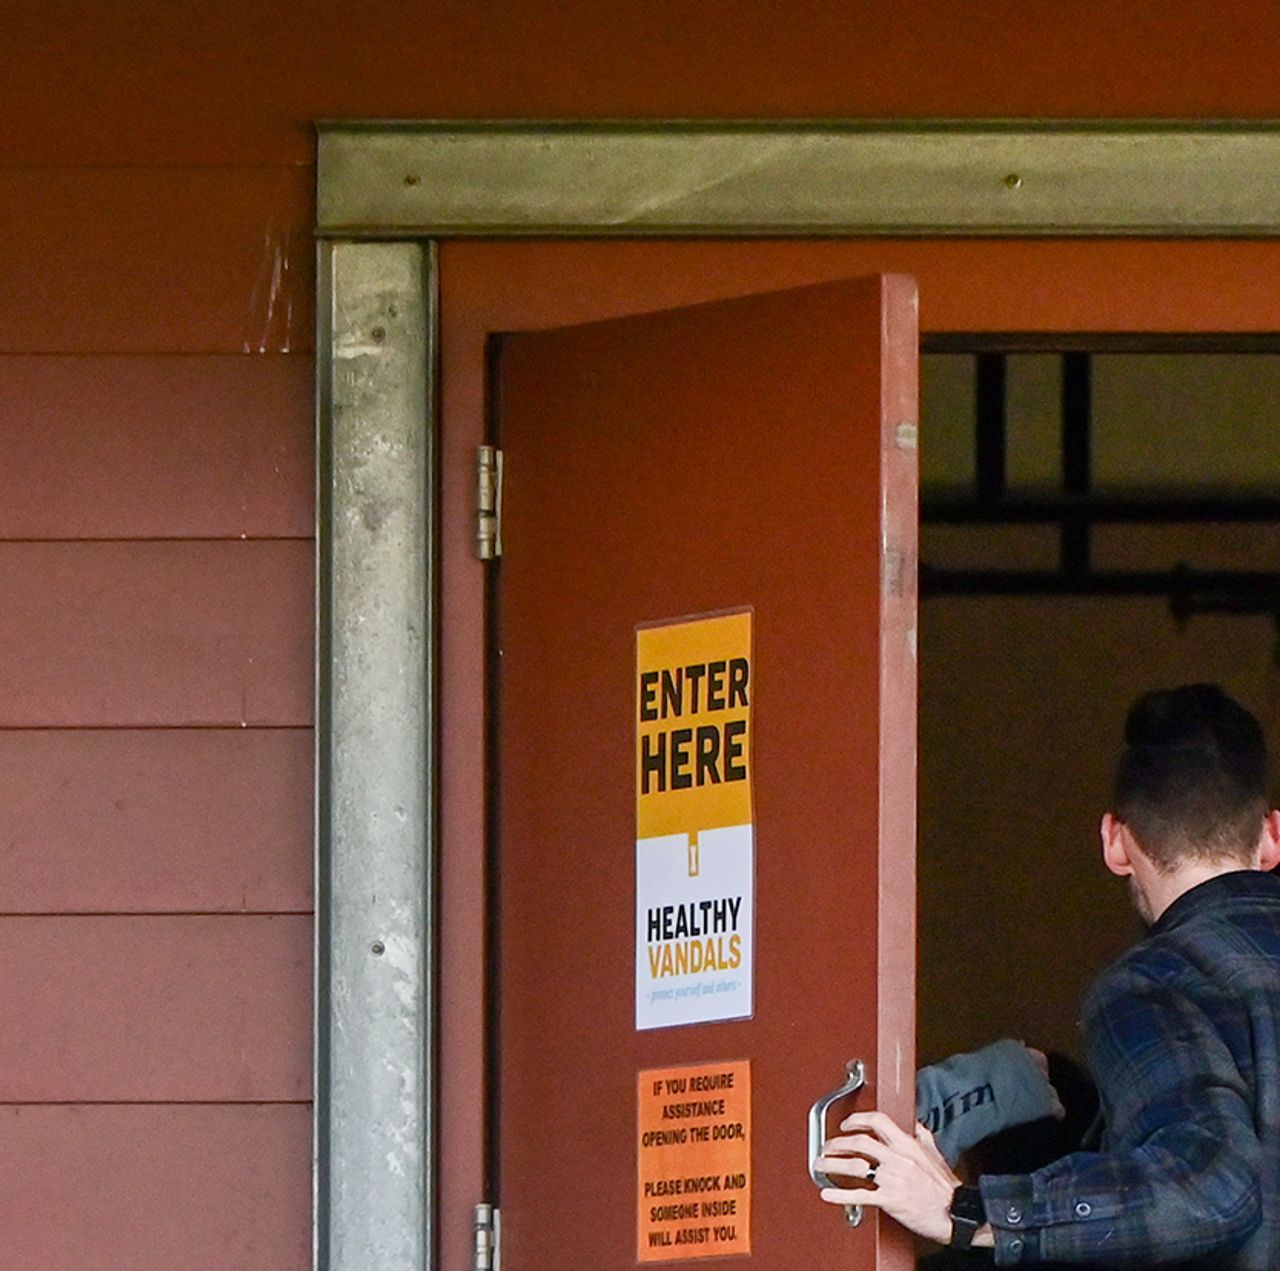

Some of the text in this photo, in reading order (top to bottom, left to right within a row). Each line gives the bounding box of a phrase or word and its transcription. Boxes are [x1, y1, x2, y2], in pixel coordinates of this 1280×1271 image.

[640, 657, 749, 722] ENTER
[641, 720, 746, 795] HERE
[647, 896, 742, 942] HEALTHY
[648, 934, 742, 979] VANDALS
[653, 1073, 734, 1096] IF YOU REQUIRE
[662, 1099, 725, 1120] ASSISTANCE
[642, 1122, 745, 1148] OPENING THE DOOR,
[644, 1173, 746, 1198] PLEASE KNOCK AND
[650, 1199, 736, 1222] SOMEONE INSIDE
[648, 1225, 737, 1247] WILL ASSIST YOU.
